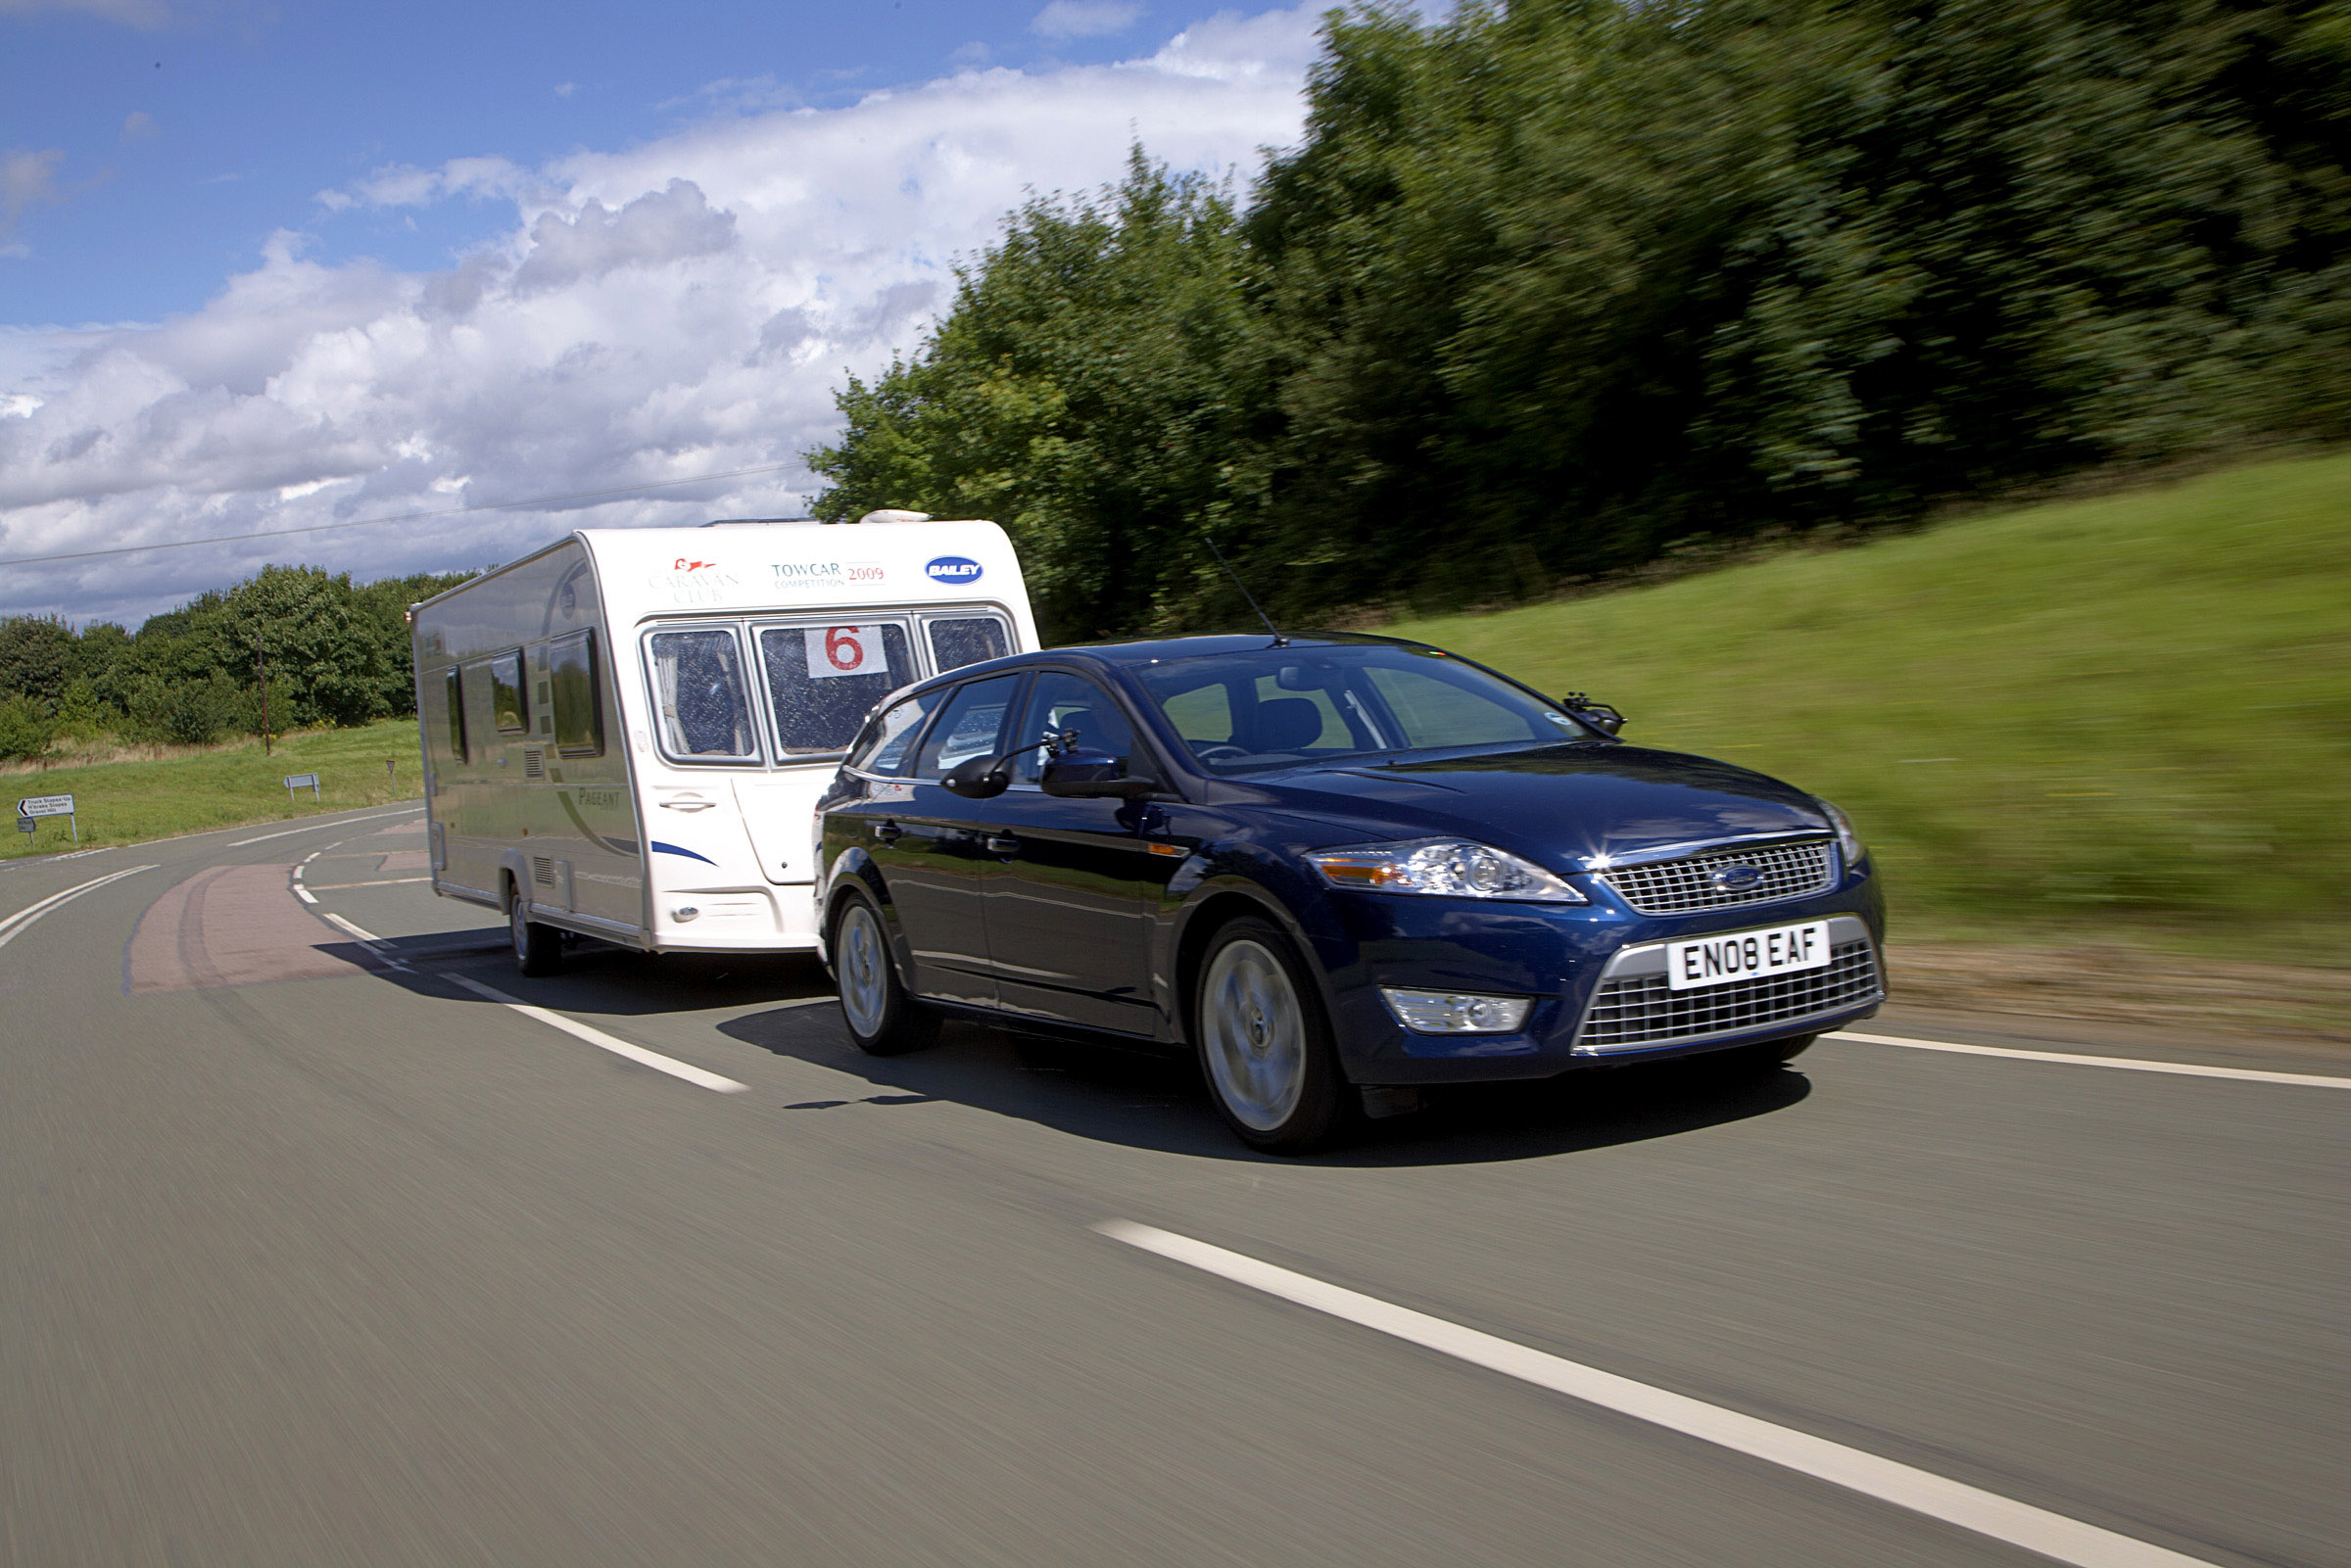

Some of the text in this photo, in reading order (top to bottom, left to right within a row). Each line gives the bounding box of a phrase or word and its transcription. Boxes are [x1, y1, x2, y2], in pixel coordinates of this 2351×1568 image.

[772, 562, 841, 578] TOWCAR
[847, 567, 885, 581] 2009
[928, 563, 981, 577] BAILEY
[774, 579, 845, 590] COMPETITION
[825, 626, 864, 671] 6
[1684, 927, 1816, 980] EN08 EAF
